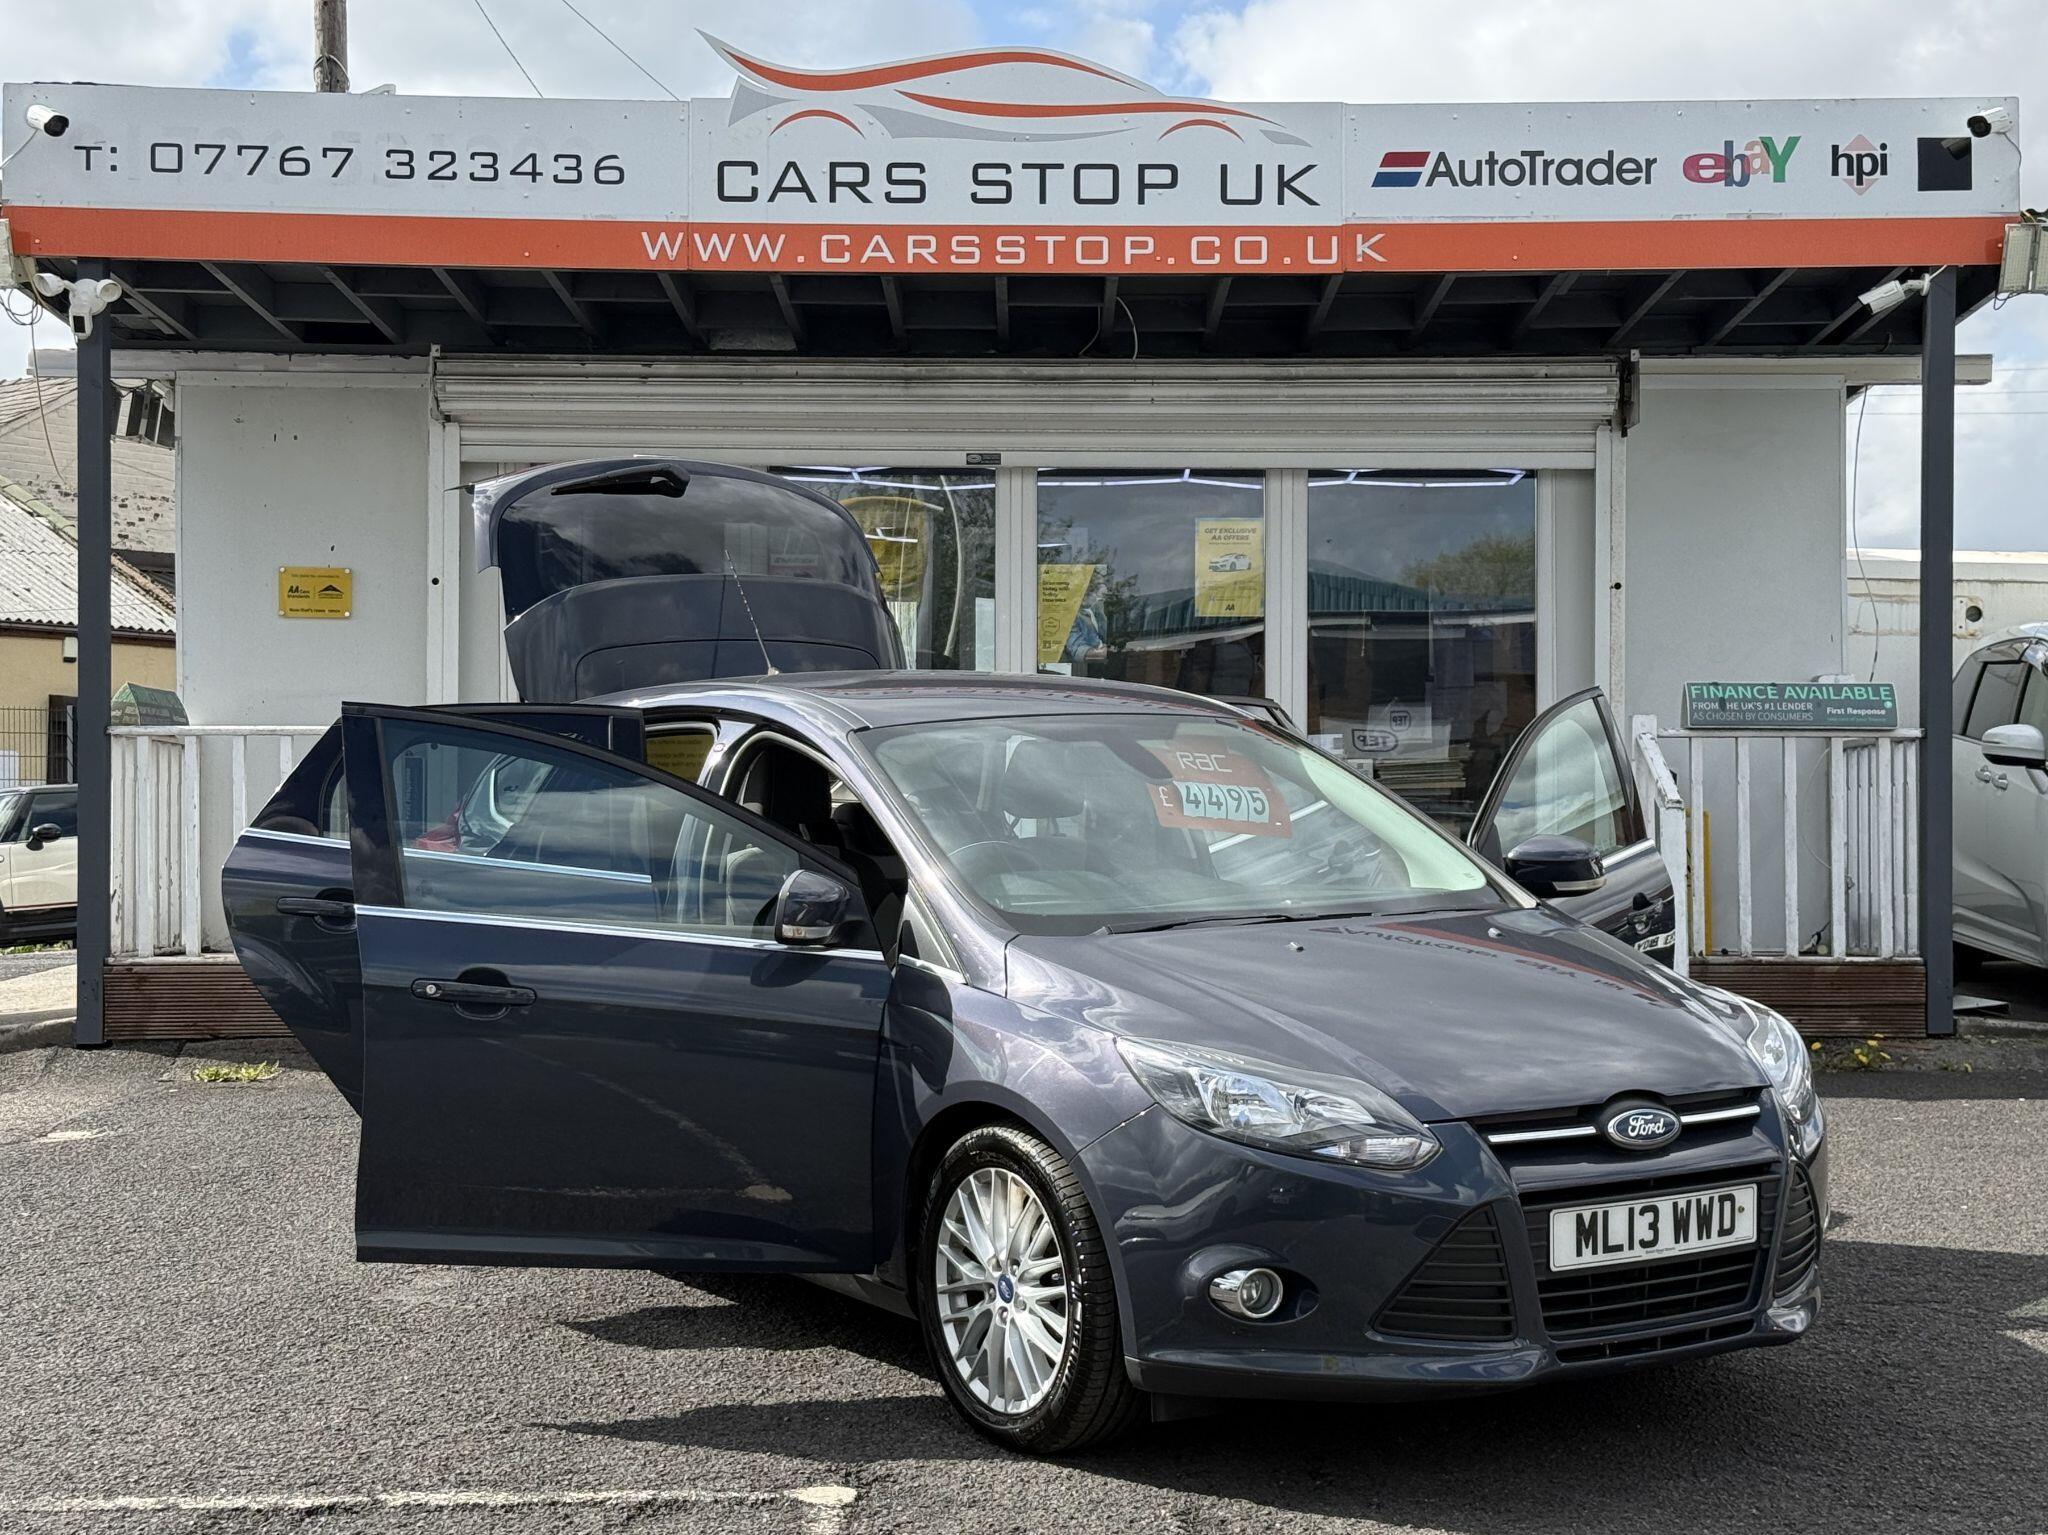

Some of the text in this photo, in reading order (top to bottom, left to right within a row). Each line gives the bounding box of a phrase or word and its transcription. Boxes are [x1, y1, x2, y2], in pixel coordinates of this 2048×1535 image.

[74, 142, 625, 185] T: 07767 323436
[1426, 150, 1658, 188] AutoTrader
[1831, 143, 1888, 188] hpi
[717, 160, 1321, 207] CARS STOP UK
[640, 230, 1387, 266] WWW.CARSSTOP.CO.UK
[288, 585, 299, 594] AA
[1225, 603, 1235, 611] AA
[1690, 685, 1892, 701] FINANCE AVAILABLE
[1692, 702, 1813, 711] FROM HE UK'S #1 LENDER
[1692, 711, 1814, 721] AS CHOSEN BY CONSUMERS
[1826, 706, 1886, 717] First Response
[1185, 785, 1266, 816] 4495
[1628, 1114, 1666, 1137] Ford
[1575, 1192, 1737, 1258] ML13 WWD
